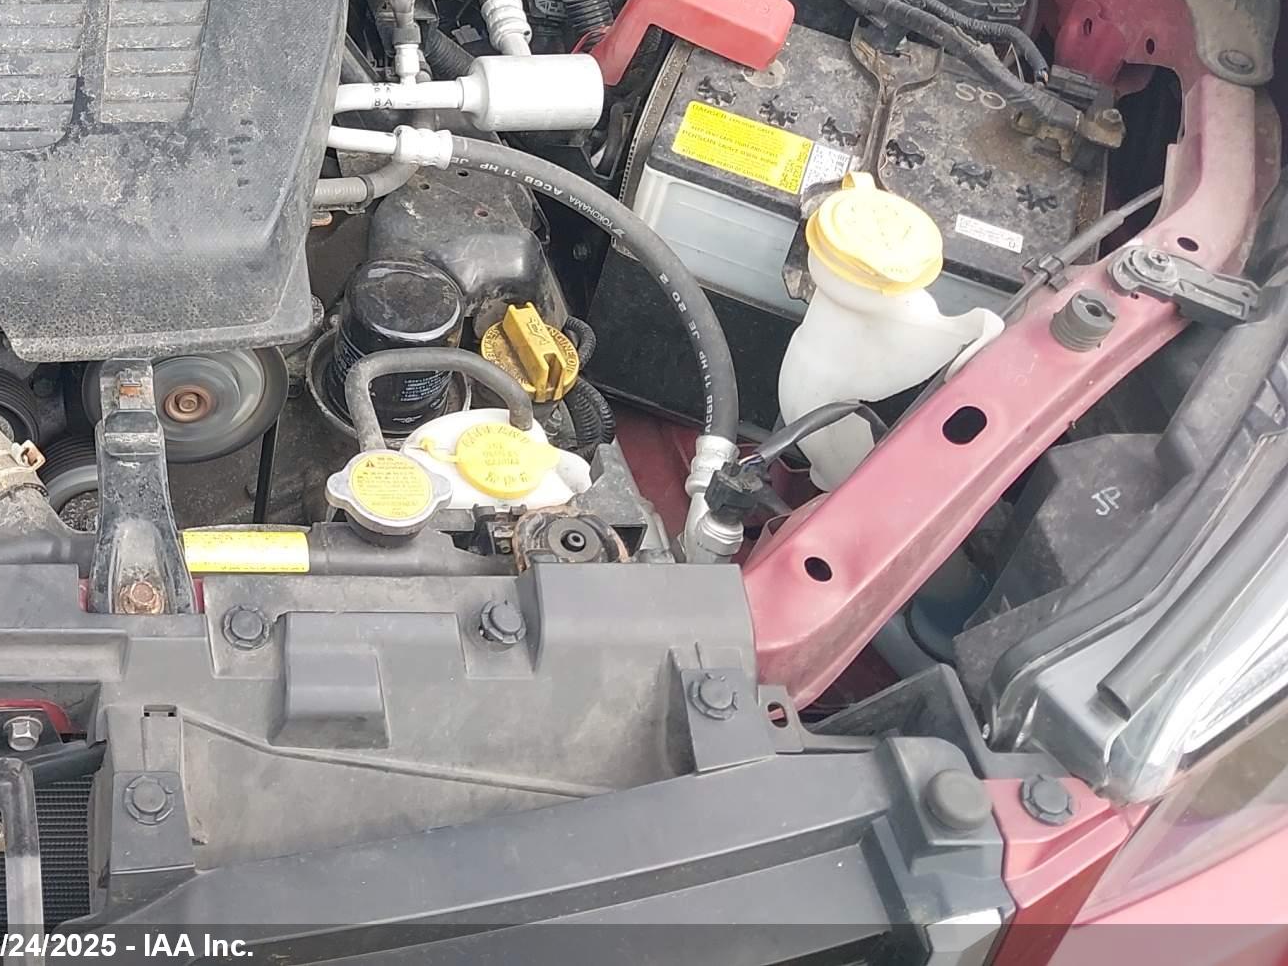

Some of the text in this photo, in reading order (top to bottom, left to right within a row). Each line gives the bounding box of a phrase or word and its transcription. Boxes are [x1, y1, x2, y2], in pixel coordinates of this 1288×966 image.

[479, 162, 499, 172] HP
[569, 195, 614, 227] YOKOHAMA
[671, 290, 687, 313] 20
[687, 319, 701, 339] JE
[698, 350, 709, 369] HP
[1091, 486, 1121, 516] JP
